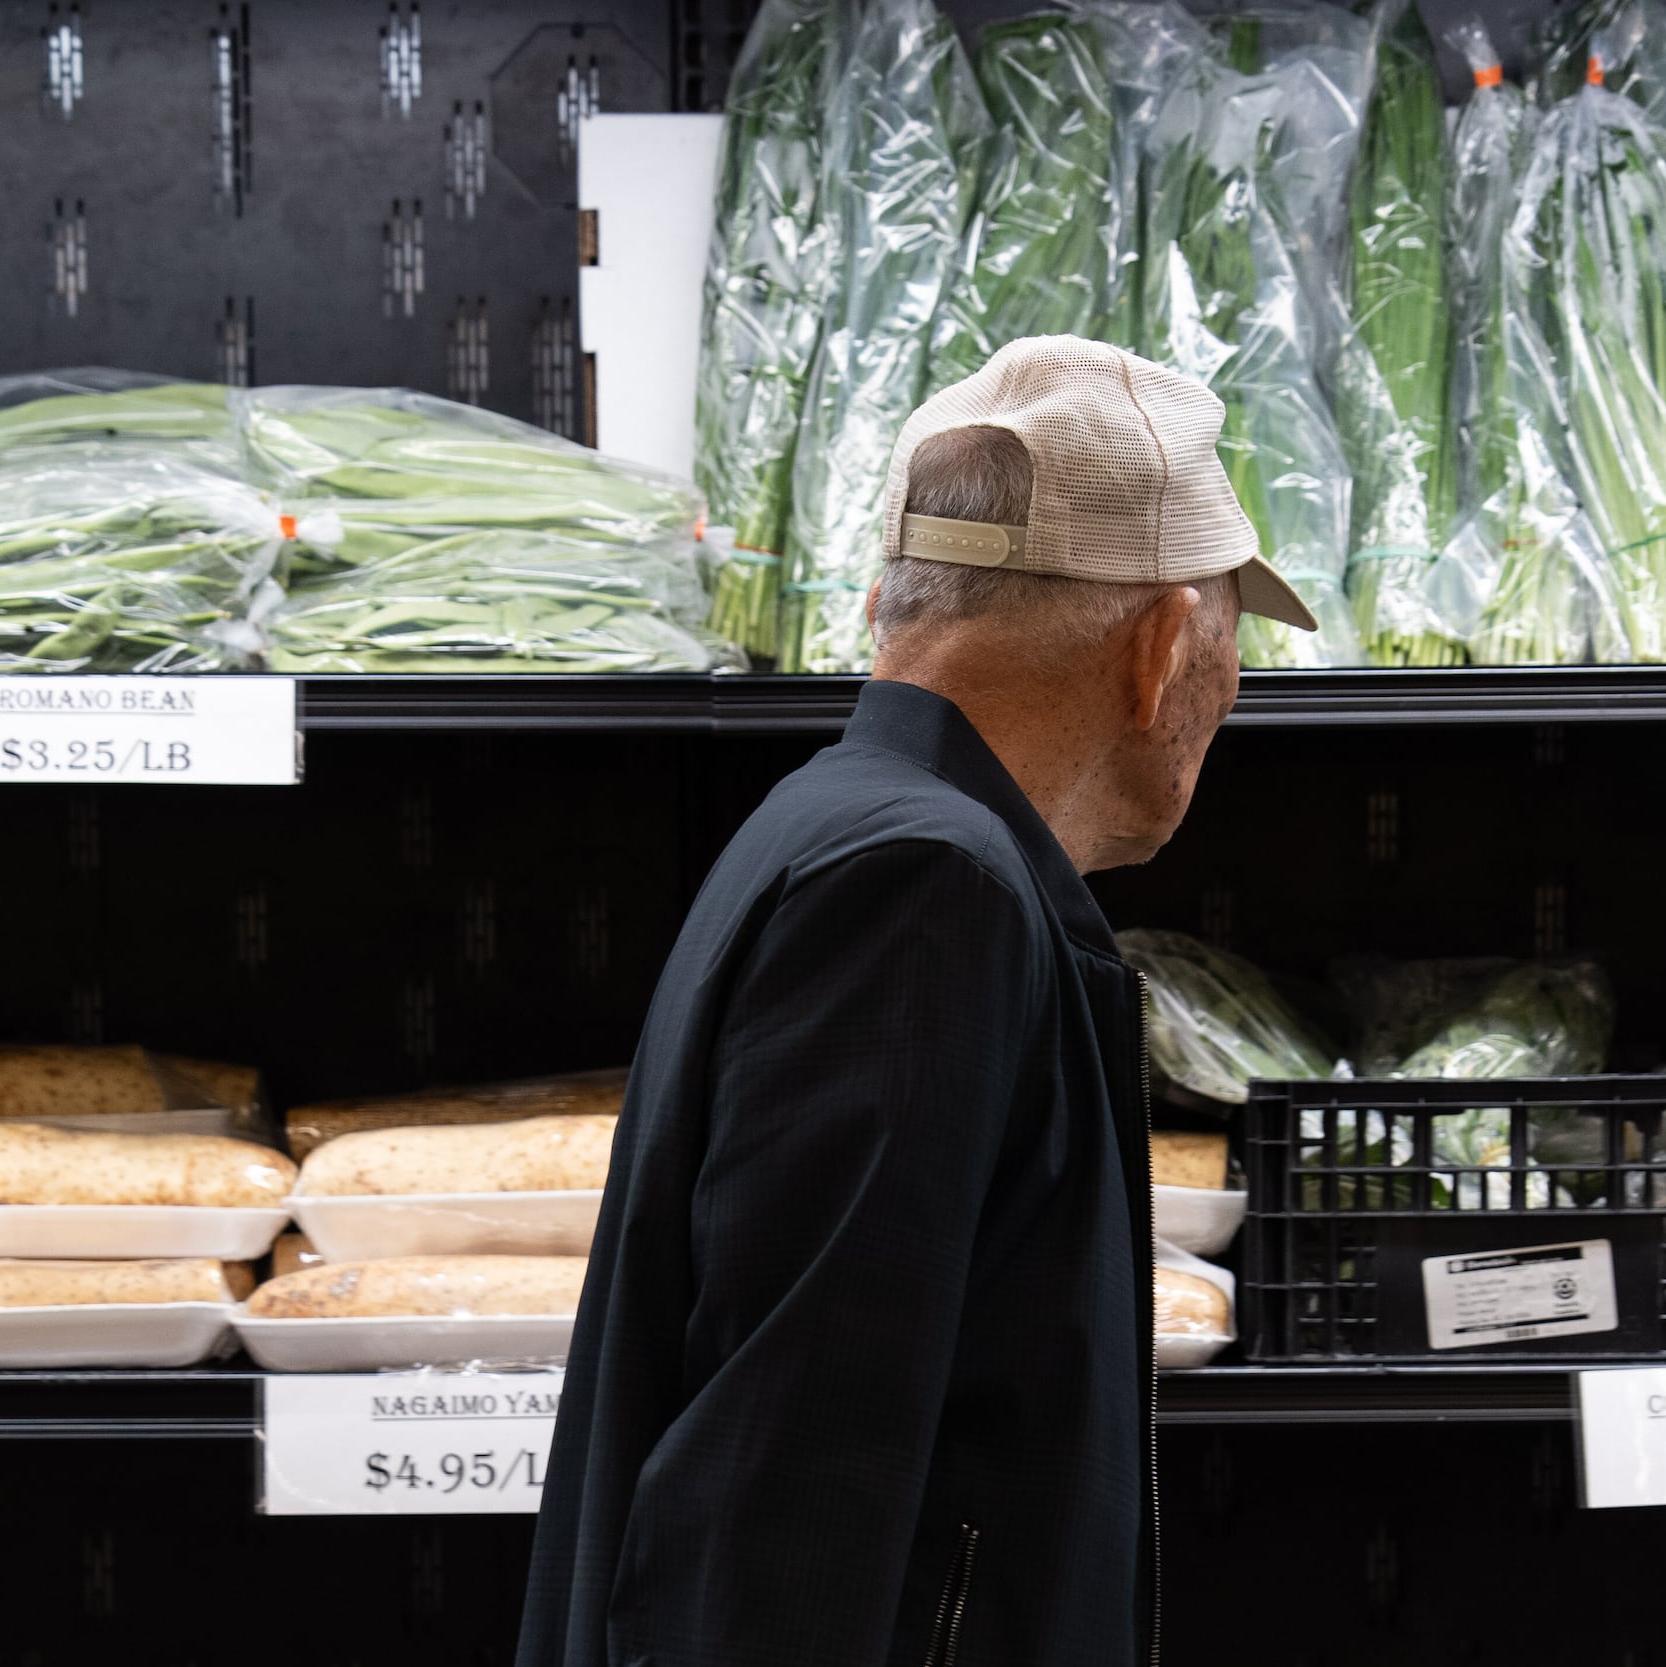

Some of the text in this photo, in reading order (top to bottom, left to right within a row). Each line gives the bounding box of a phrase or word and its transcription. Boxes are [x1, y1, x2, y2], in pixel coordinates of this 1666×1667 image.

[121, 689, 196, 711] BEAN
[0, 738, 192, 774] $3.25/LB
[372, 1395, 498, 1416] NAGAIMO
